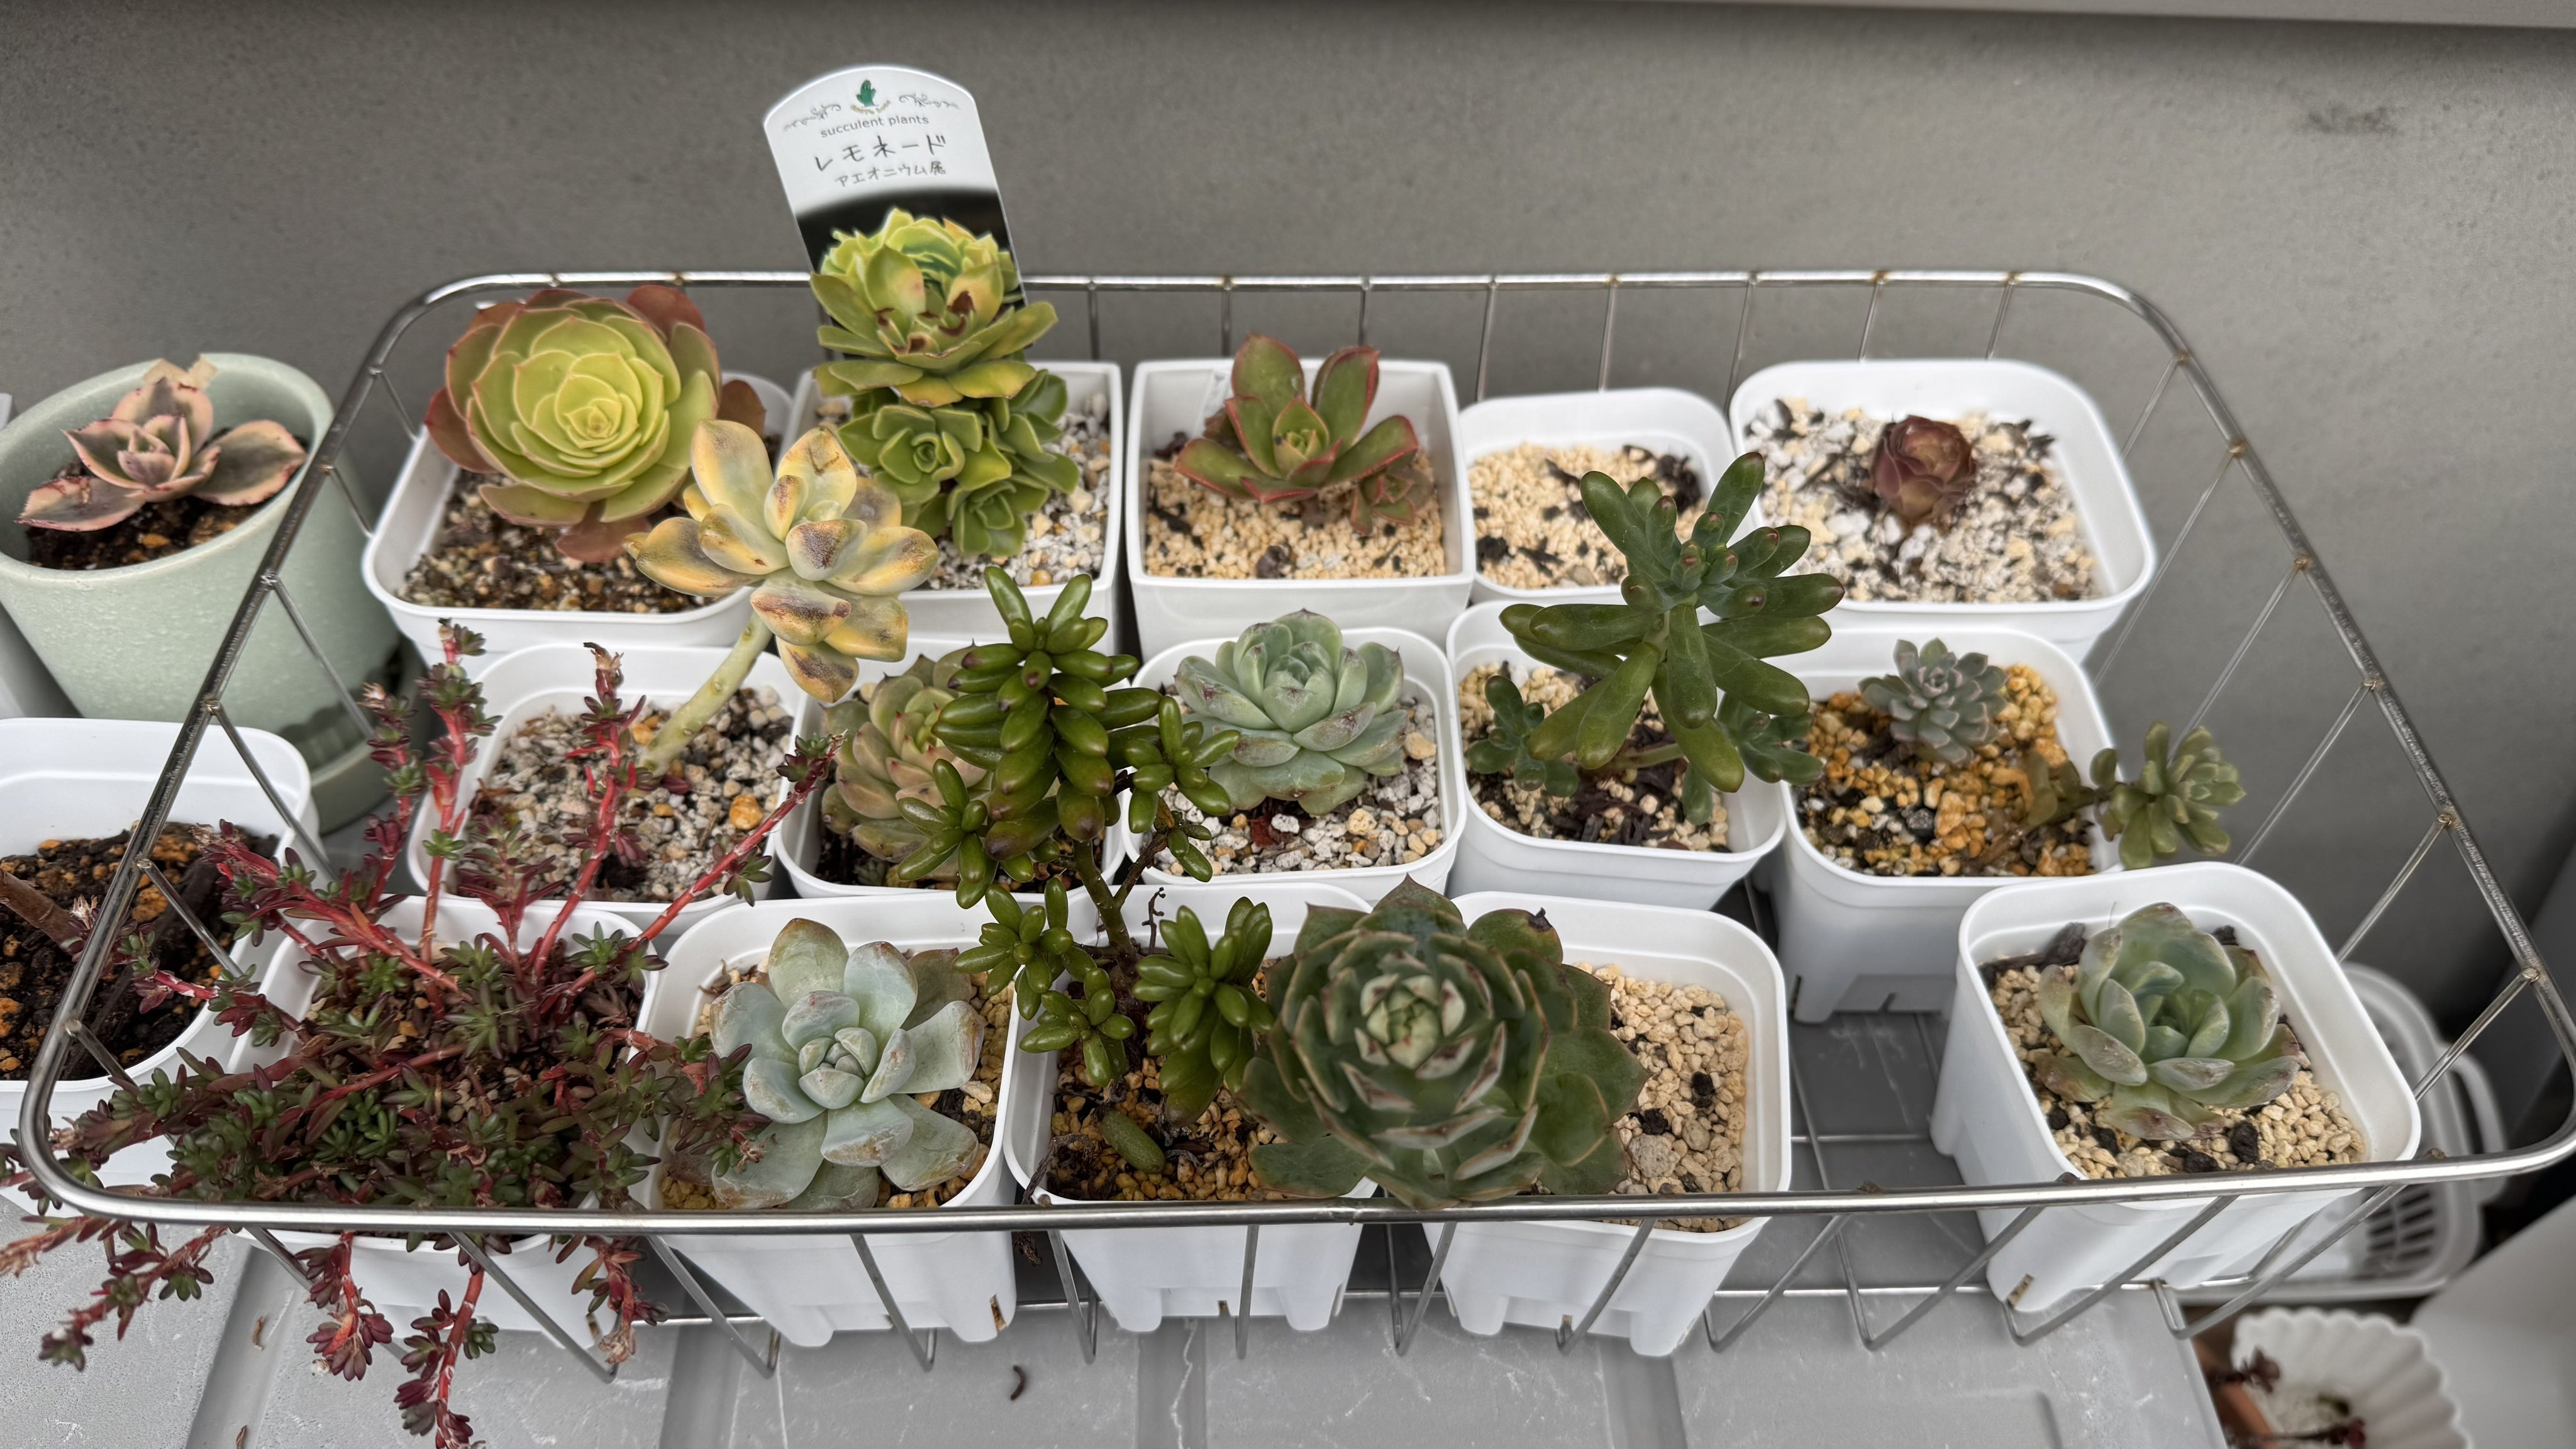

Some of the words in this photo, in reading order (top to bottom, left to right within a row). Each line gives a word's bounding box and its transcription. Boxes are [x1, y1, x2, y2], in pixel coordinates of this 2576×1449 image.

[820, 117, 884, 138] succulent
[889, 115, 930, 126] plants
[815, 135, 946, 172] レモネード
[835, 160, 946, 187] アエオニウム属
